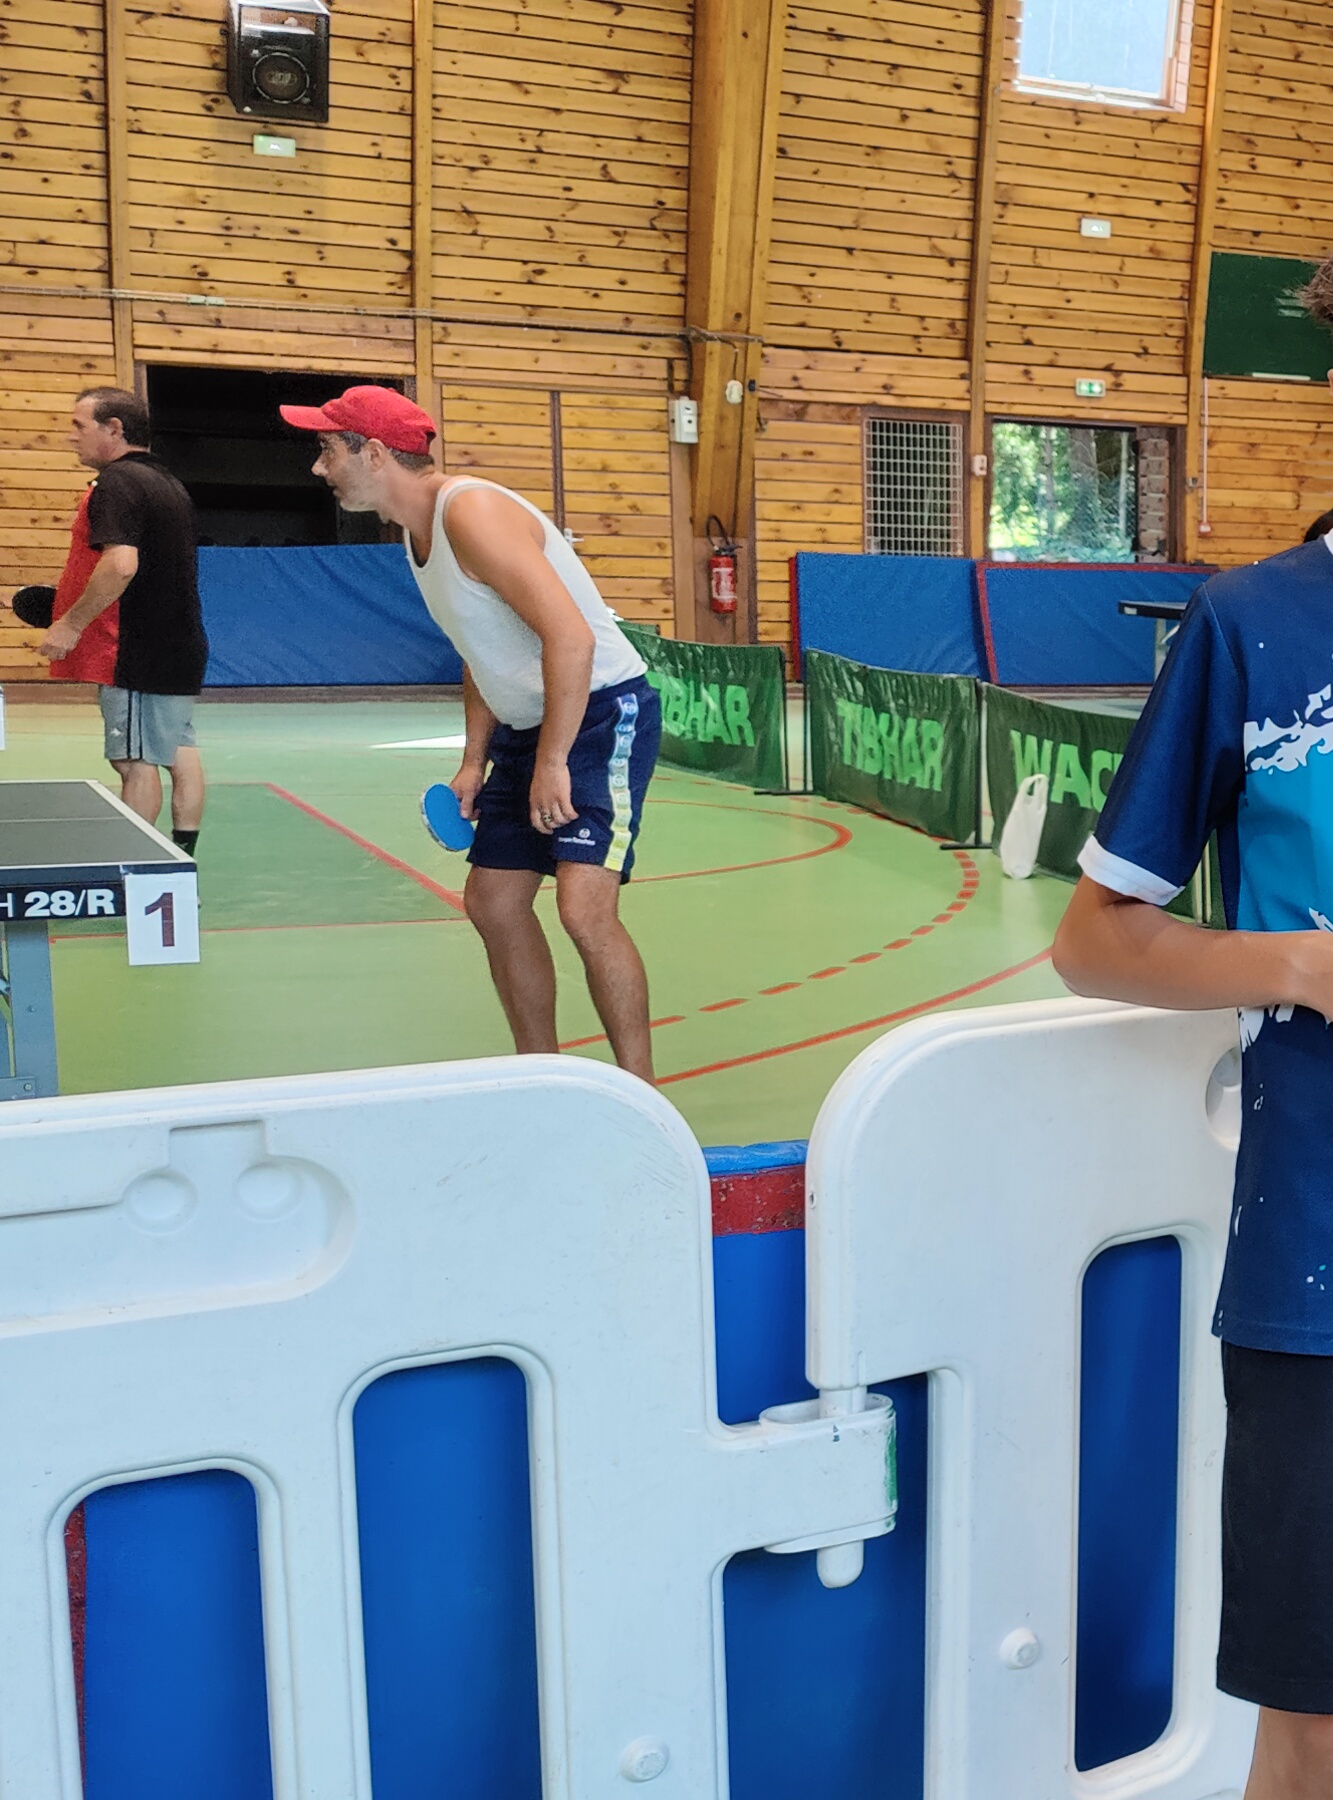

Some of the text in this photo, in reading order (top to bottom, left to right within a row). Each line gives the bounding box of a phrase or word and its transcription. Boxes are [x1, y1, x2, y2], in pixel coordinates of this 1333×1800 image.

[836, 699, 942, 791] TIBHAR
[1009, 729, 1124, 813] WAC
[24, 888, 115, 918] 28/R
[144, 892, 175, 947] 1
